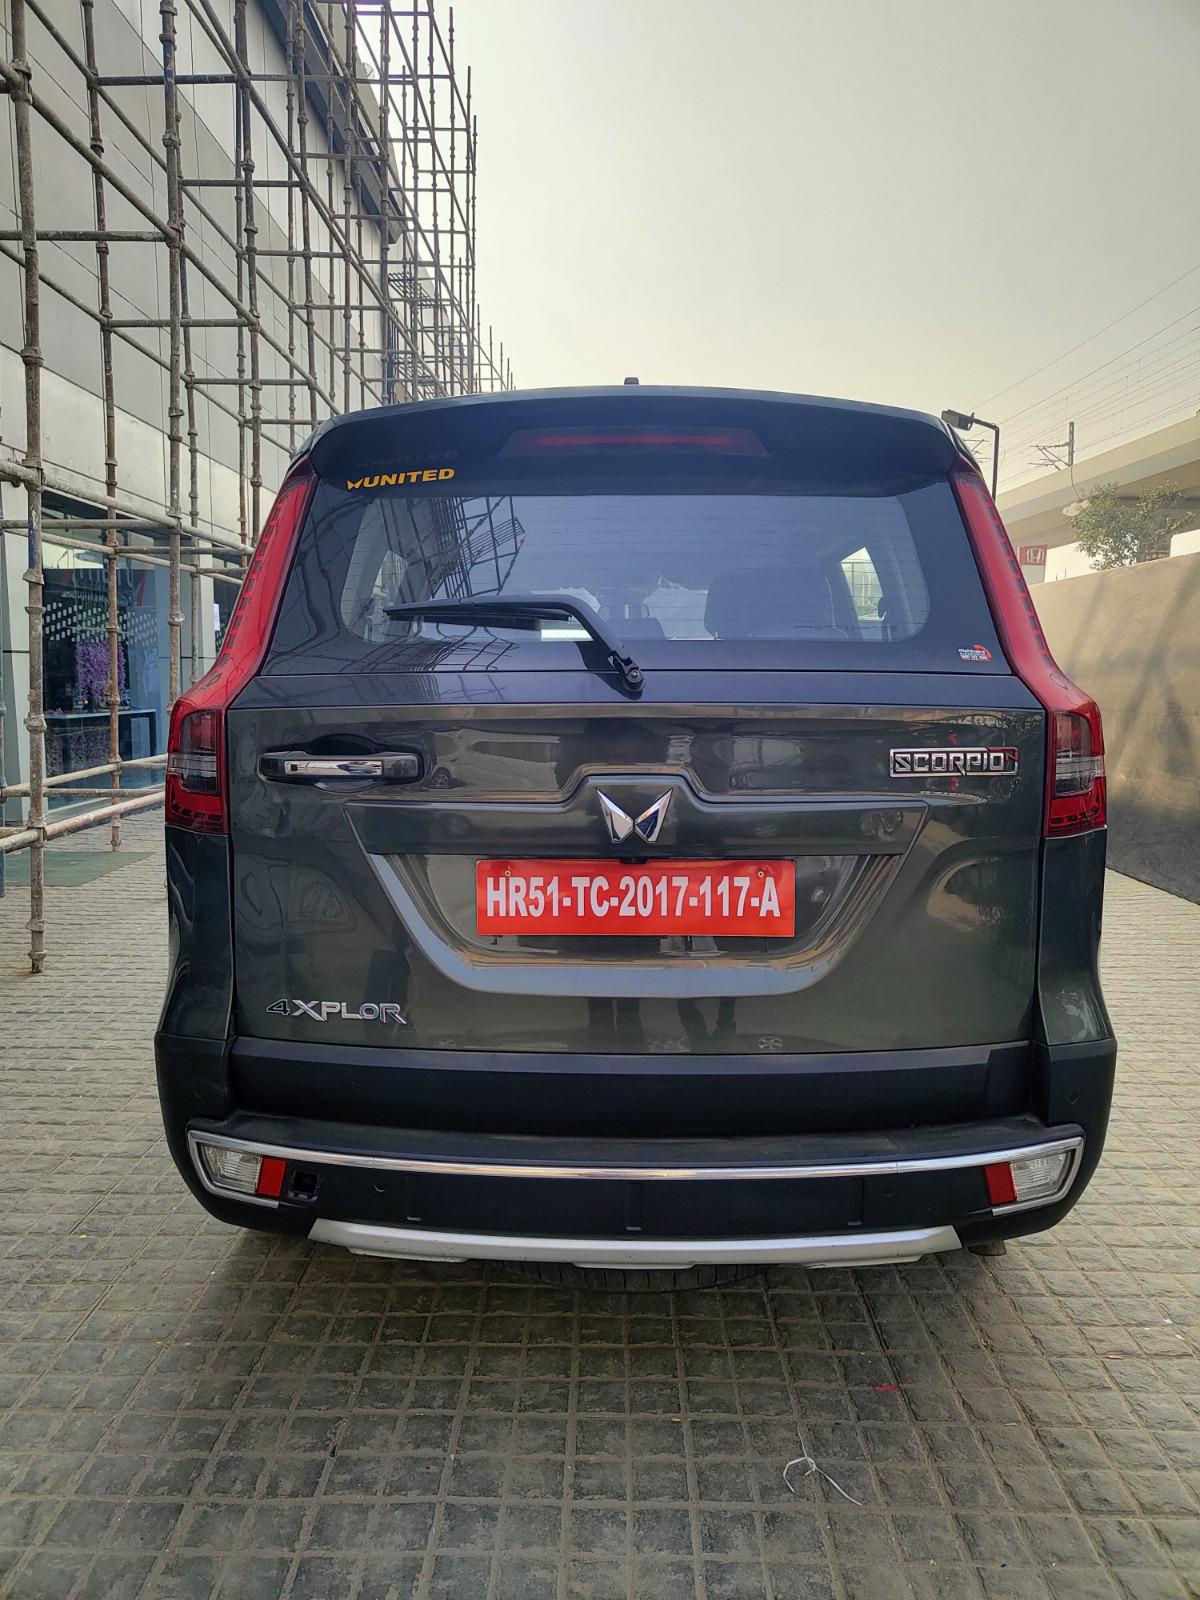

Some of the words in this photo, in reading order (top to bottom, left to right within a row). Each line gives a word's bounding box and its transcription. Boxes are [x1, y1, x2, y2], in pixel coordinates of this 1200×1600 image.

[362, 468, 455, 488] UNITED
[486, 875, 781, 918] HR51-TC-2017-117-A
[266, 998, 408, 1025] 4XPLOR
